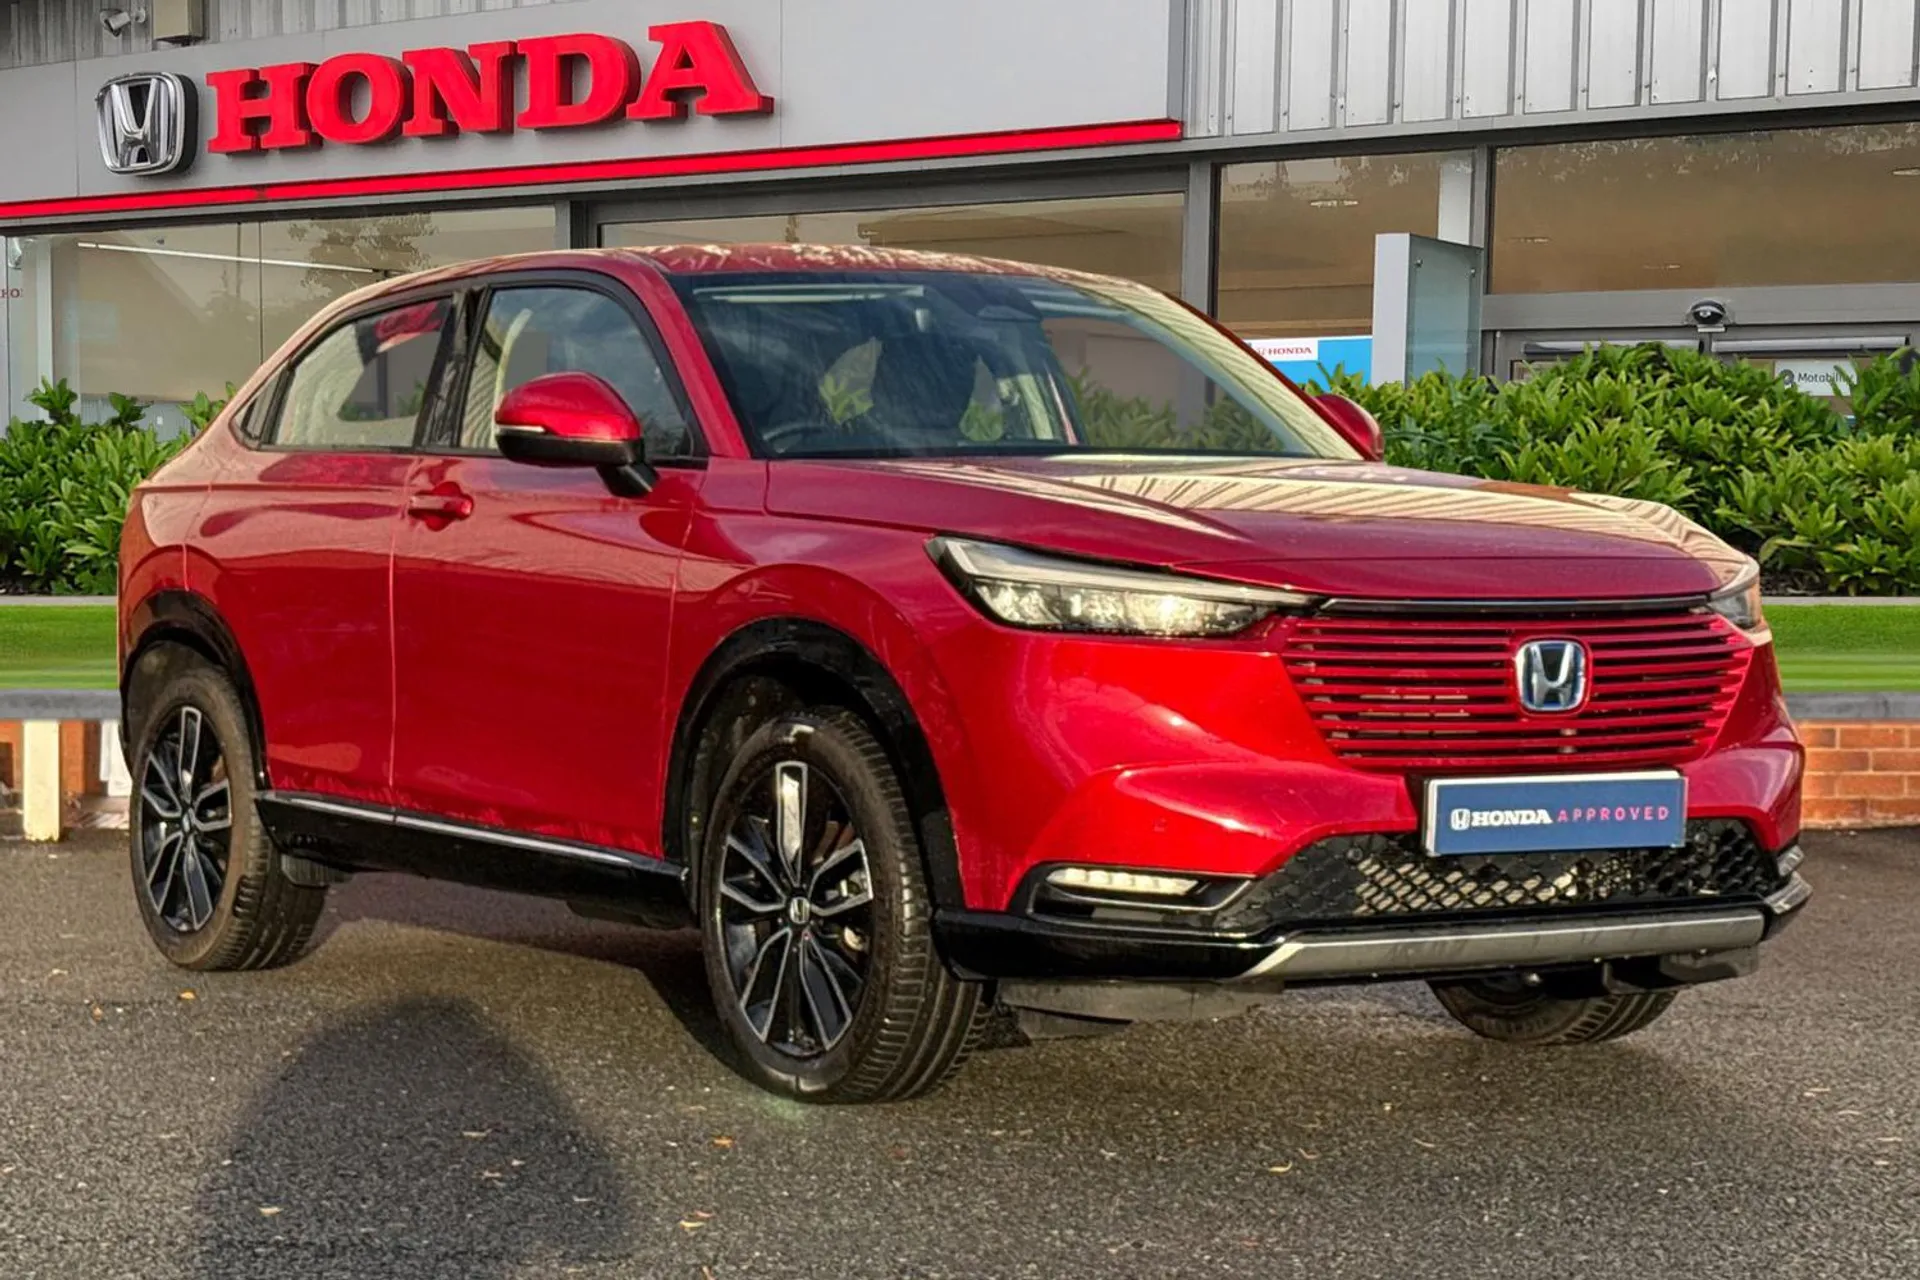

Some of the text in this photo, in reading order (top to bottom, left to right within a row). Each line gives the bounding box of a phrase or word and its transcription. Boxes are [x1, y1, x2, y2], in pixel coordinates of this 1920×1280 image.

[206, 20, 774, 154] HONDA
[1, 287, 24, 299] HO
[1268, 347, 1312, 355] HONDA
[1797, 372, 1856, 384] Motabili
[1471, 809, 1552, 827] HONDA
[1557, 806, 1669, 823] APPROVED
